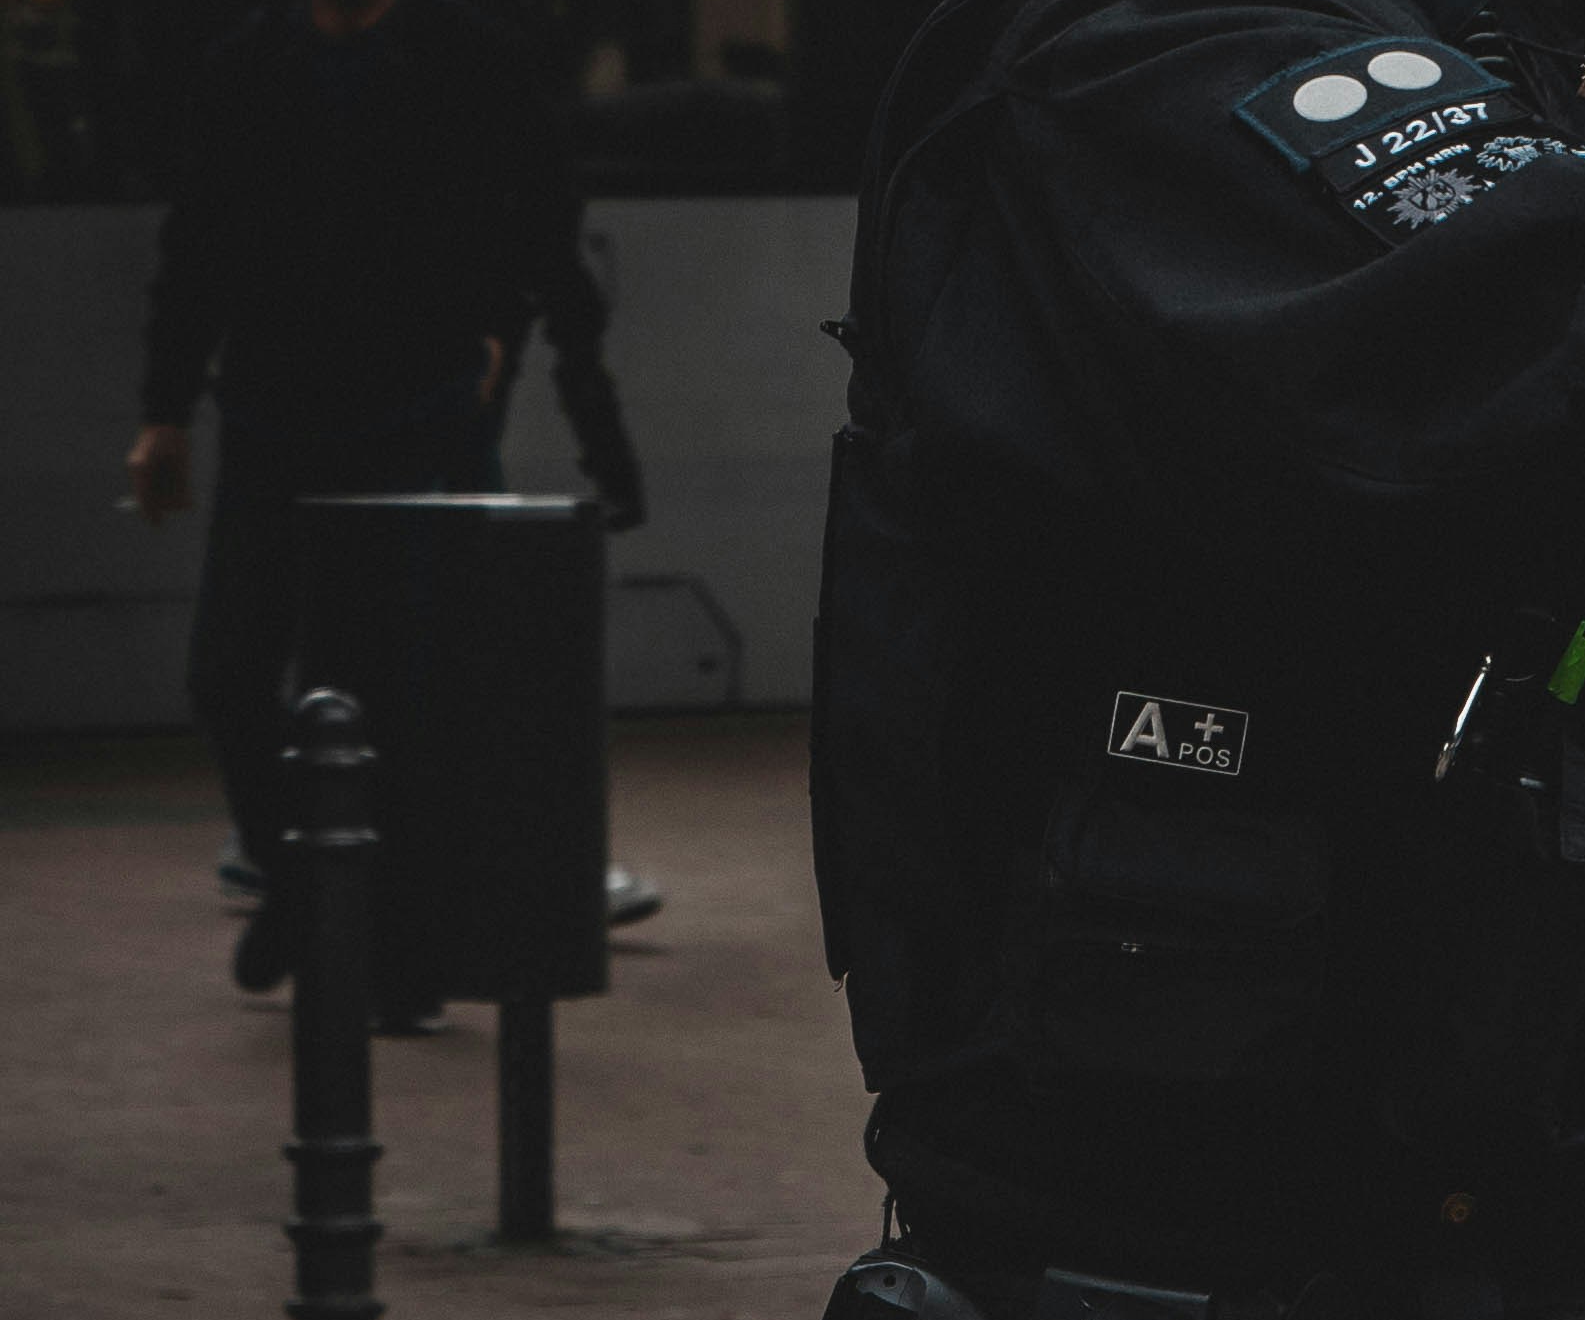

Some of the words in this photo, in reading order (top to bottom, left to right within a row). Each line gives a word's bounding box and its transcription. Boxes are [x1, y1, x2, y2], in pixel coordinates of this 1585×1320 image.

[1354, 142, 1377, 168] J
[1381, 101, 1489, 156] 22/37
[1353, 190, 1384, 210] 12.
[1425, 143, 1472, 166] NRW
[1119, 701, 1170, 759] A
[1178, 742, 1231, 768] POS
